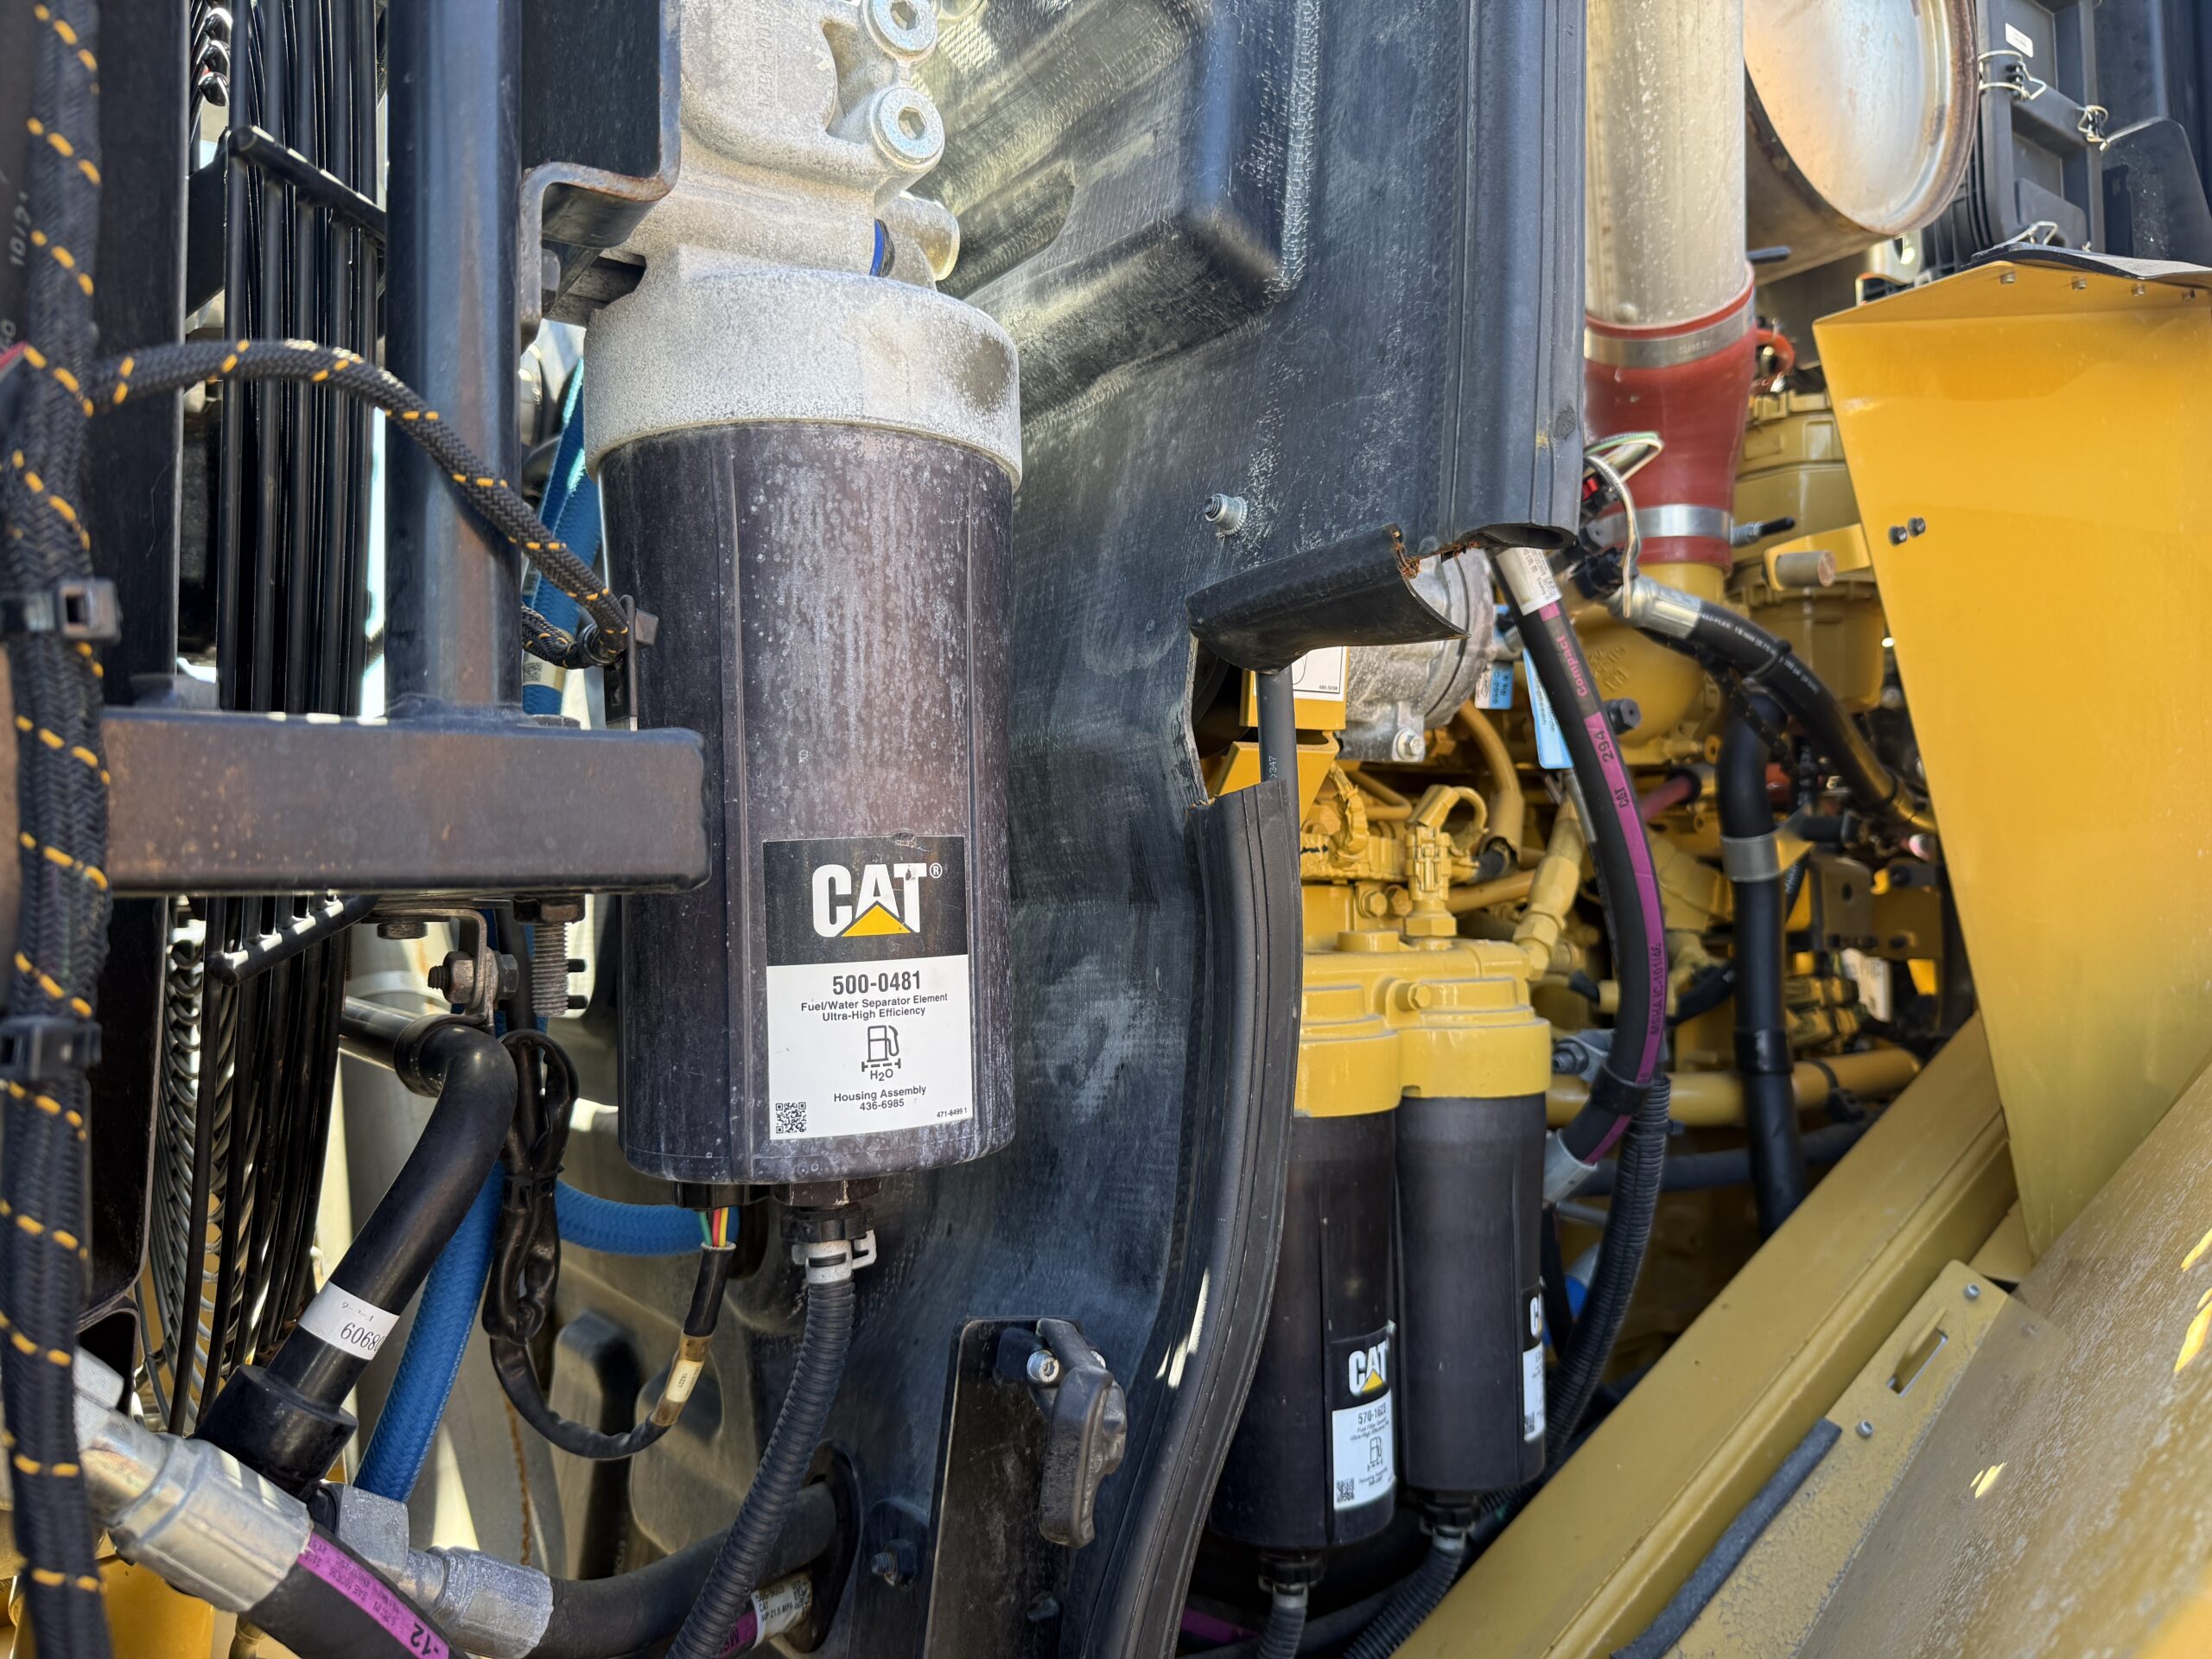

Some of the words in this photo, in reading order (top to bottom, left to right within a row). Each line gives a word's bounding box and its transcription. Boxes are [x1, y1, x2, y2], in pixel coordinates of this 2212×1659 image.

[1555, 634, 1587, 696] Compact
[1596, 730, 1614, 763] 294
[1614, 786, 1630, 809] CAT
[832, 970, 921, 995] 500-0481
[801, 998, 859, 1012] Fuel/Water
[861, 995, 910, 1011] Separator
[913, 993, 948, 1004] Element
[823, 1007, 876, 1022] Ultra-High
[879, 1006, 926, 1018] Efficiency
[834, 1090, 877, 1103] Housing
[880, 1084, 927, 1100] Assembly
[859, 1098, 905, 1111] 436-6985
[1349, 1340, 1389, 1396] CAT
[410, 1622, 439, 1656] -12
